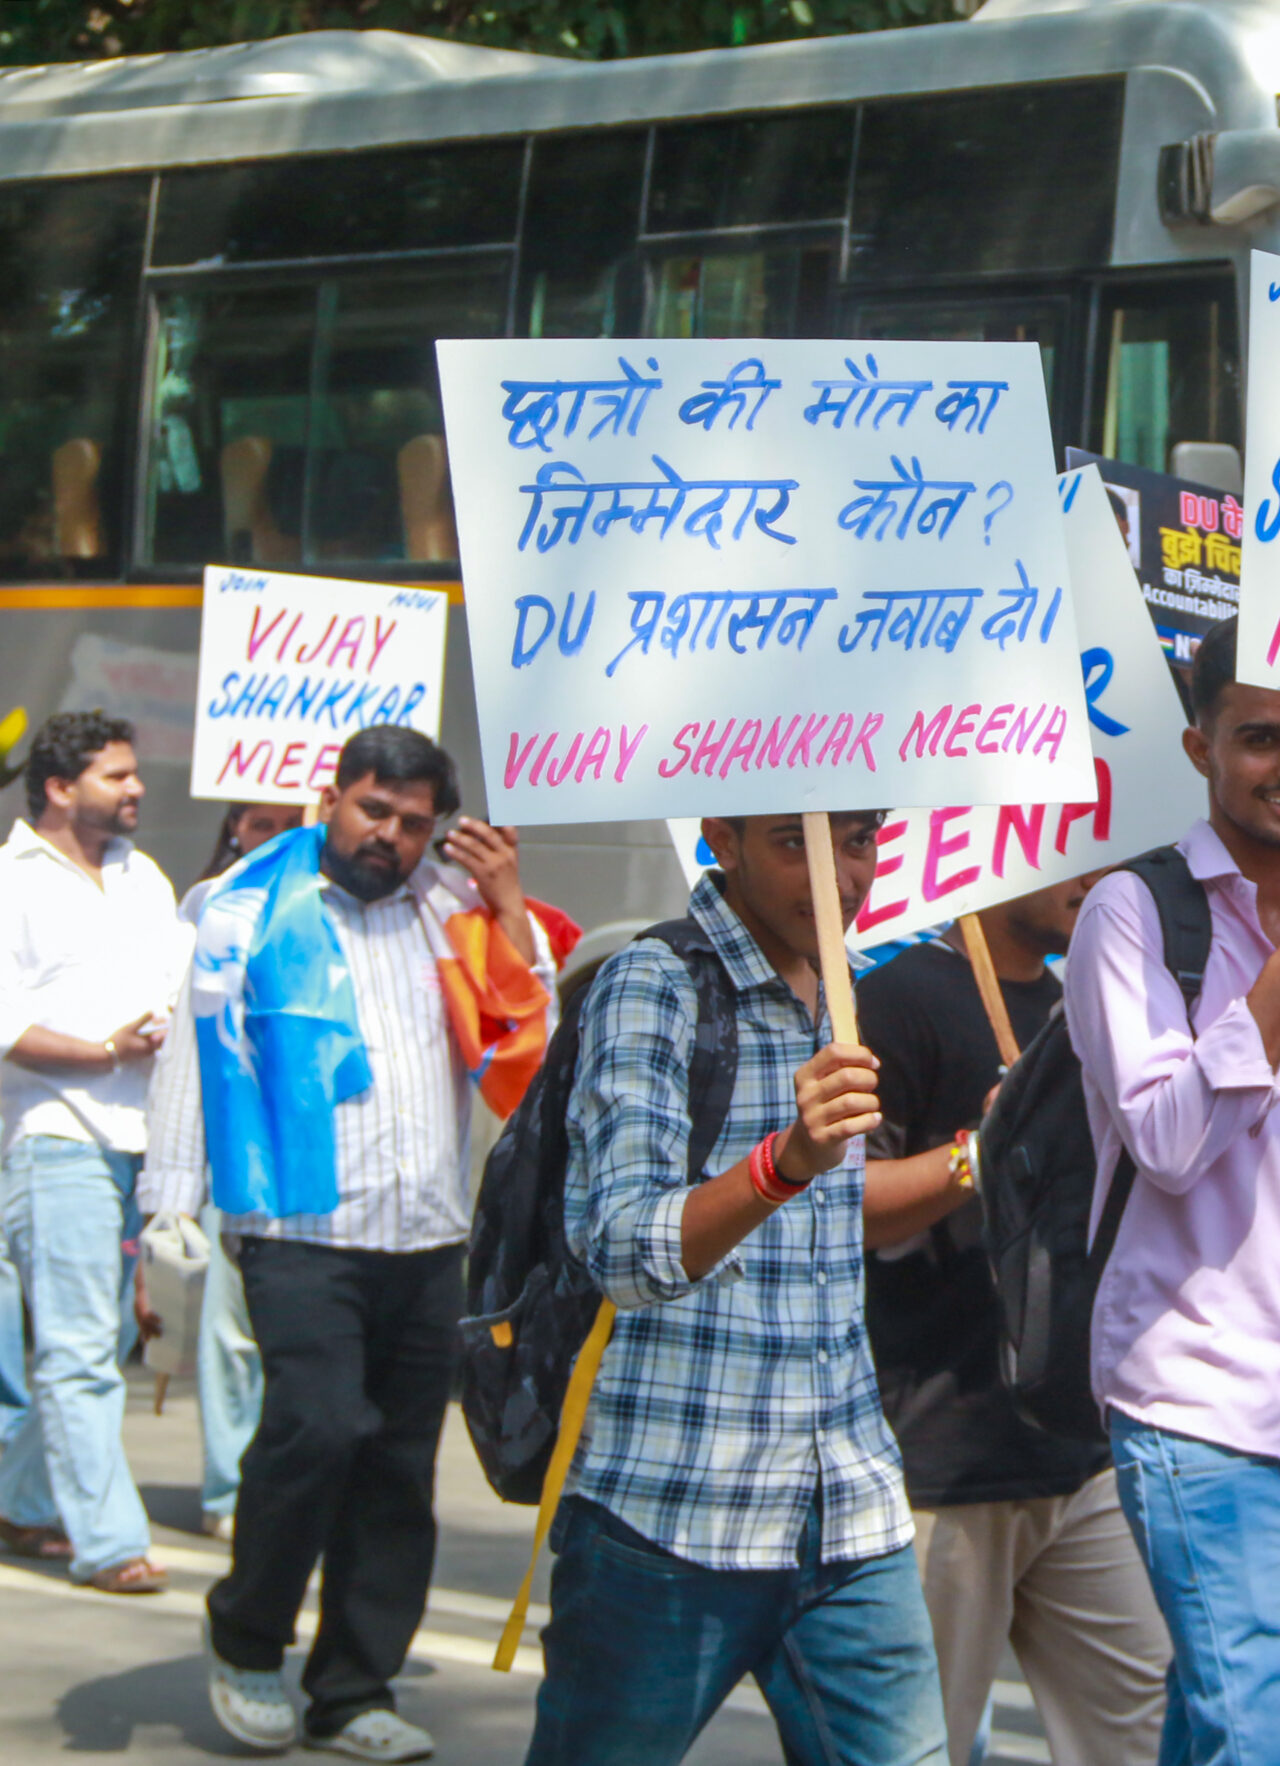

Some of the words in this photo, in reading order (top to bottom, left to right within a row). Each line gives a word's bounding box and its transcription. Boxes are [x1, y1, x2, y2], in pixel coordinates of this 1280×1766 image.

[500, 355, 663, 452] छात्रों
[679, 358, 782, 431] की
[803, 352, 932, 430] मौत
[935, 380, 1008, 434] का
[518, 454, 799, 552] जिम्मेदार
[1179, 491, 1218, 532] DU
[220, 572, 269, 593] JOIN
[1162, 567, 1182, 589] का
[247, 605, 397, 673] VIJAY
[509, 589, 597, 669] DU
[604, 586, 838, 678] प्रशासन
[837, 588, 983, 654] जवाब
[208, 672, 426, 729] SHANKKAR
[216, 739, 344, 791] MEE
[503, 722, 650, 790] VIJAY
[658, 711, 885, 781] SHANKAR
[899, 702, 1068, 764] MEENA
[856, 756, 1112, 934] EENA
